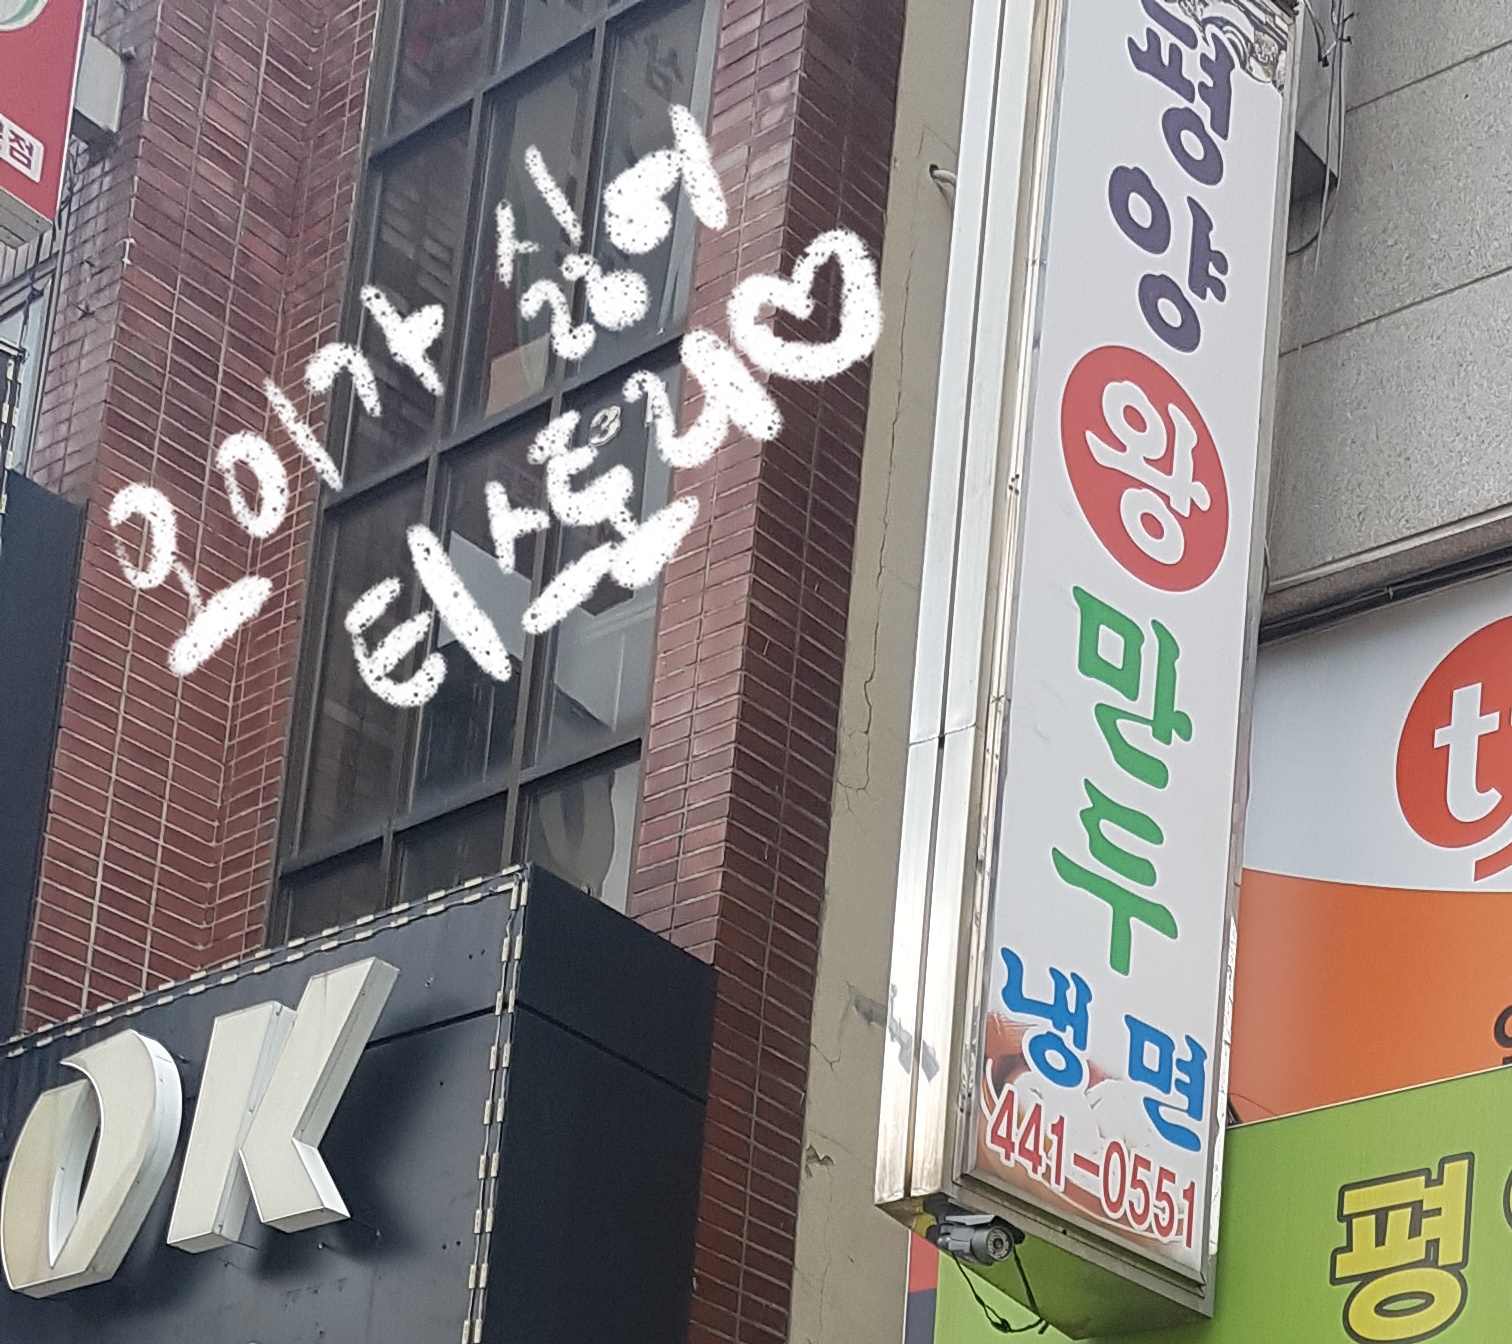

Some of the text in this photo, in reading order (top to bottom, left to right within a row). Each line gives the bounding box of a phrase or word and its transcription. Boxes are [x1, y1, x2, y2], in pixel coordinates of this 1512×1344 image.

[1085, 380, 1212, 566] 왕
[1051, 584, 1194, 977] 만두
[0, 957, 400, 1298] OK
[1000, 946, 1209, 1153] 냉면
[988, 1089, 1198, 1250] 441-0551
